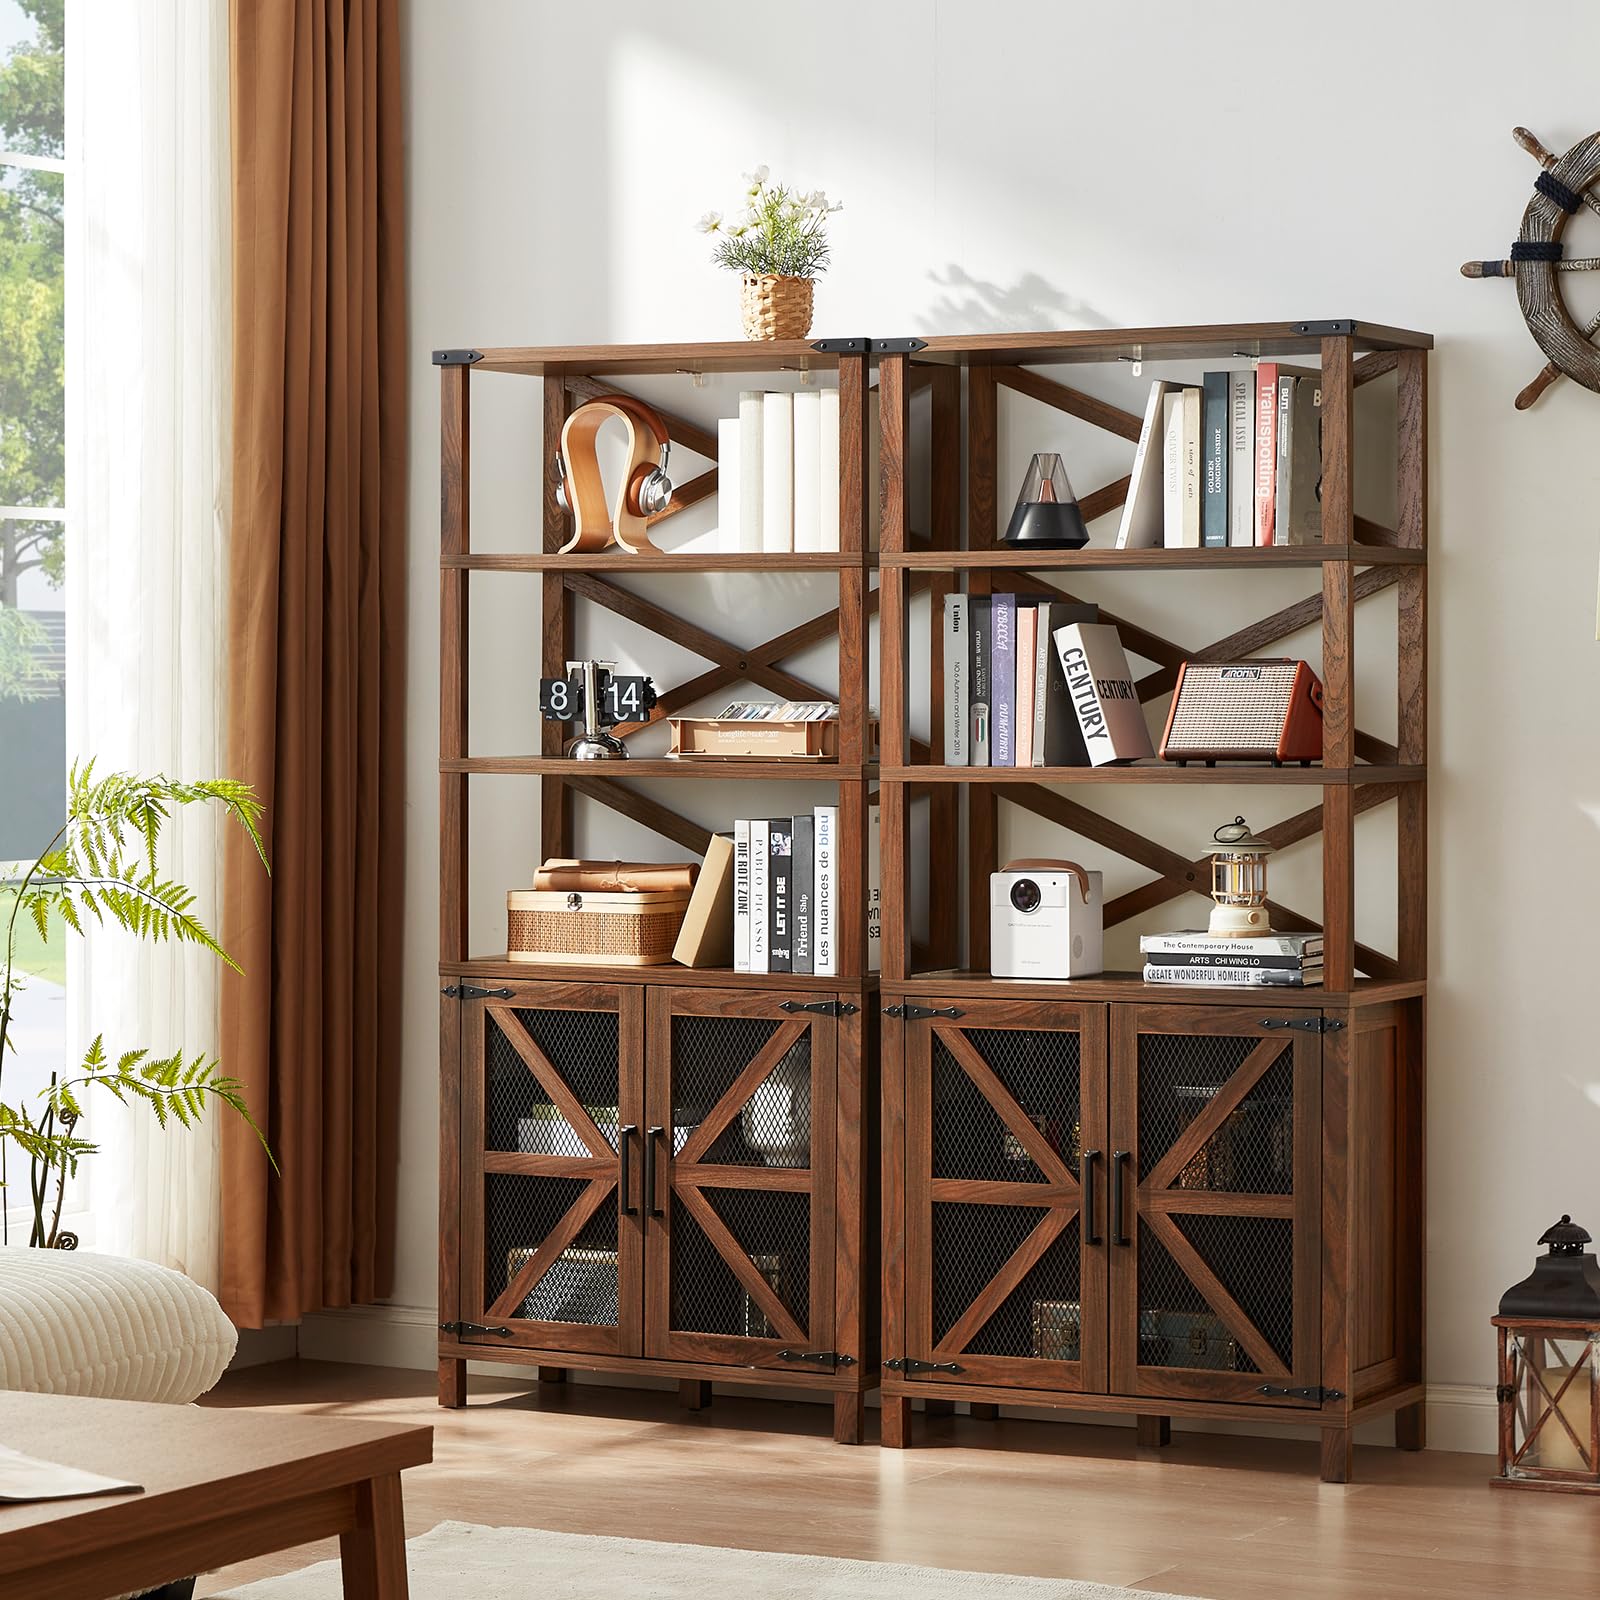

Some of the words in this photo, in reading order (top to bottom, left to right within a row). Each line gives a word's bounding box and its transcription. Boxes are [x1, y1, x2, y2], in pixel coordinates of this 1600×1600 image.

[1235, 382, 1247, 422] SPECIAL
[1169, 430, 1177, 465] OLIVER
[1235, 426, 1247, 452] ISSUE
[1256, 382, 1275, 498] Trainspotting
[1169, 467, 1177, 495] TWIST
[1187, 468, 1195, 477] of
[953, 604, 961, 633] Union
[997, 602, 1009, 651] REBECCA
[550, 681, 568, 711] 8
[608, 682, 640, 712] 14
[1037, 689, 1045, 711] WING
[1063, 647, 1108, 740] CENTURY
[1096, 679, 1135, 700] CENTURY
[1036, 711, 1044, 722] LO
[818, 815, 829, 846] bleu
[737, 842, 748, 858] DIE
[755, 839, 763, 886] PABLO
[818, 851, 829, 868] de
[737, 861, 748, 887] ROTE
[776, 876, 786, 894] BE
[738, 889, 748, 916] ZONE
[776, 896, 786, 909] IT
[800, 893, 809, 913] Ship
[820, 873, 829, 935] nuances
[755, 894, 763, 953] PICASSO
[776, 911, 786, 935] LET
[797, 915, 808, 958] Friend
[1177, 941, 1230, 951] Contemporary
[818, 940, 829, 966] Les
[1189, 956, 1210, 964] ARTS
[1214, 957, 1228, 965] CHI
[1228, 957, 1249, 966] WING
[1249, 958, 1260, 966] LO
[1147, 968, 1172, 980] CREATE
[1174, 969, 1216, 981] WONDERFUL
[1217, 970, 1250, 982] HOMELIFE
